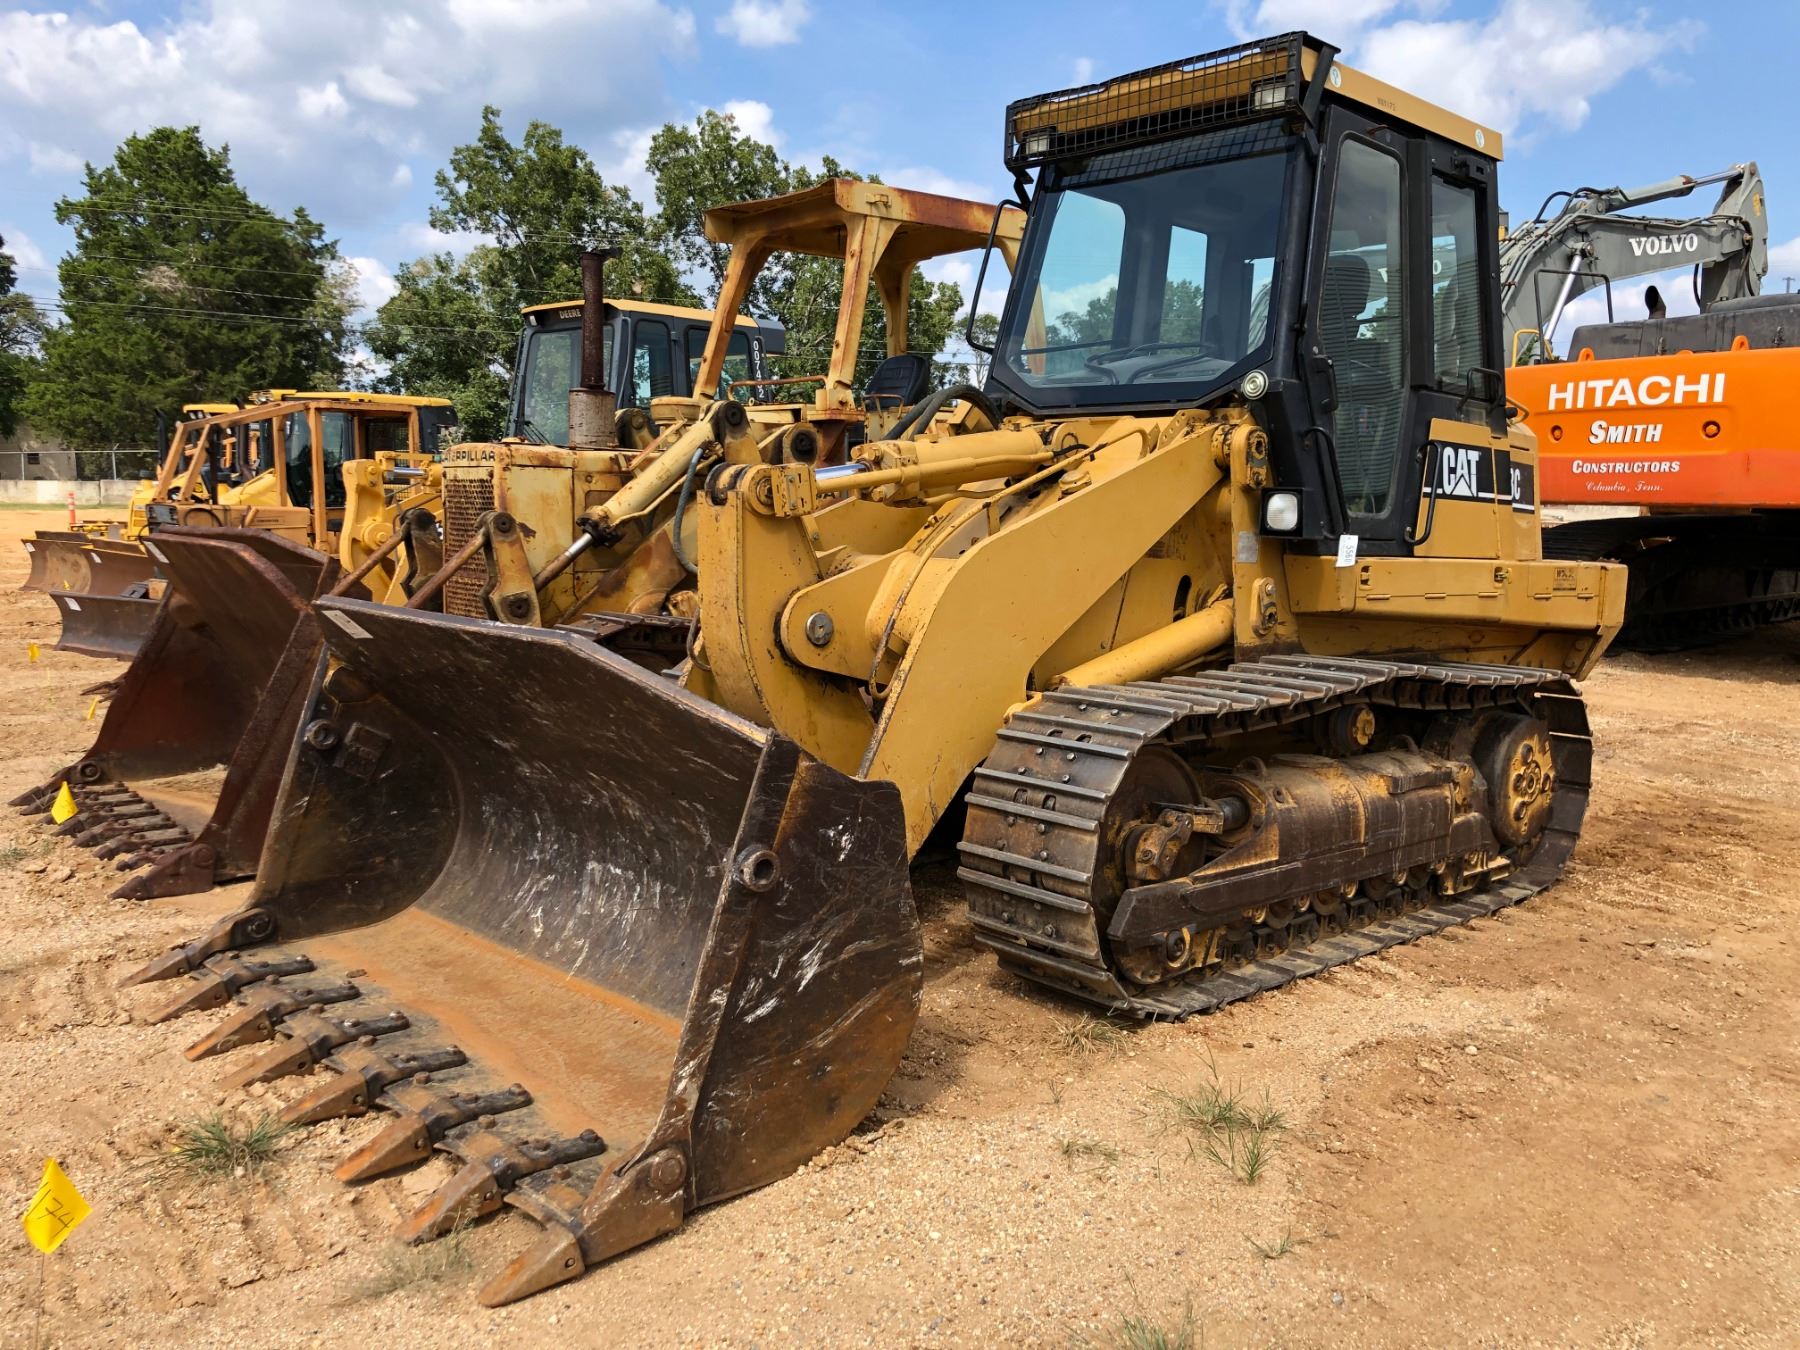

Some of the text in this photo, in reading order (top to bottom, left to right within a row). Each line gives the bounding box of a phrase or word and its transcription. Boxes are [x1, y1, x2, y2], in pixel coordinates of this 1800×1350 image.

[1628, 233, 1698, 257] VOLVO
[559, 308, 582, 319] DEERE
[1548, 373, 1726, 411] HITACHI
[1588, 420, 1663, 445] SMITH
[441, 450, 496, 462] ATERPILLAR
[1572, 459, 1681, 474] CONSTRUCTORS
[1442, 446, 1480, 497] CAT
